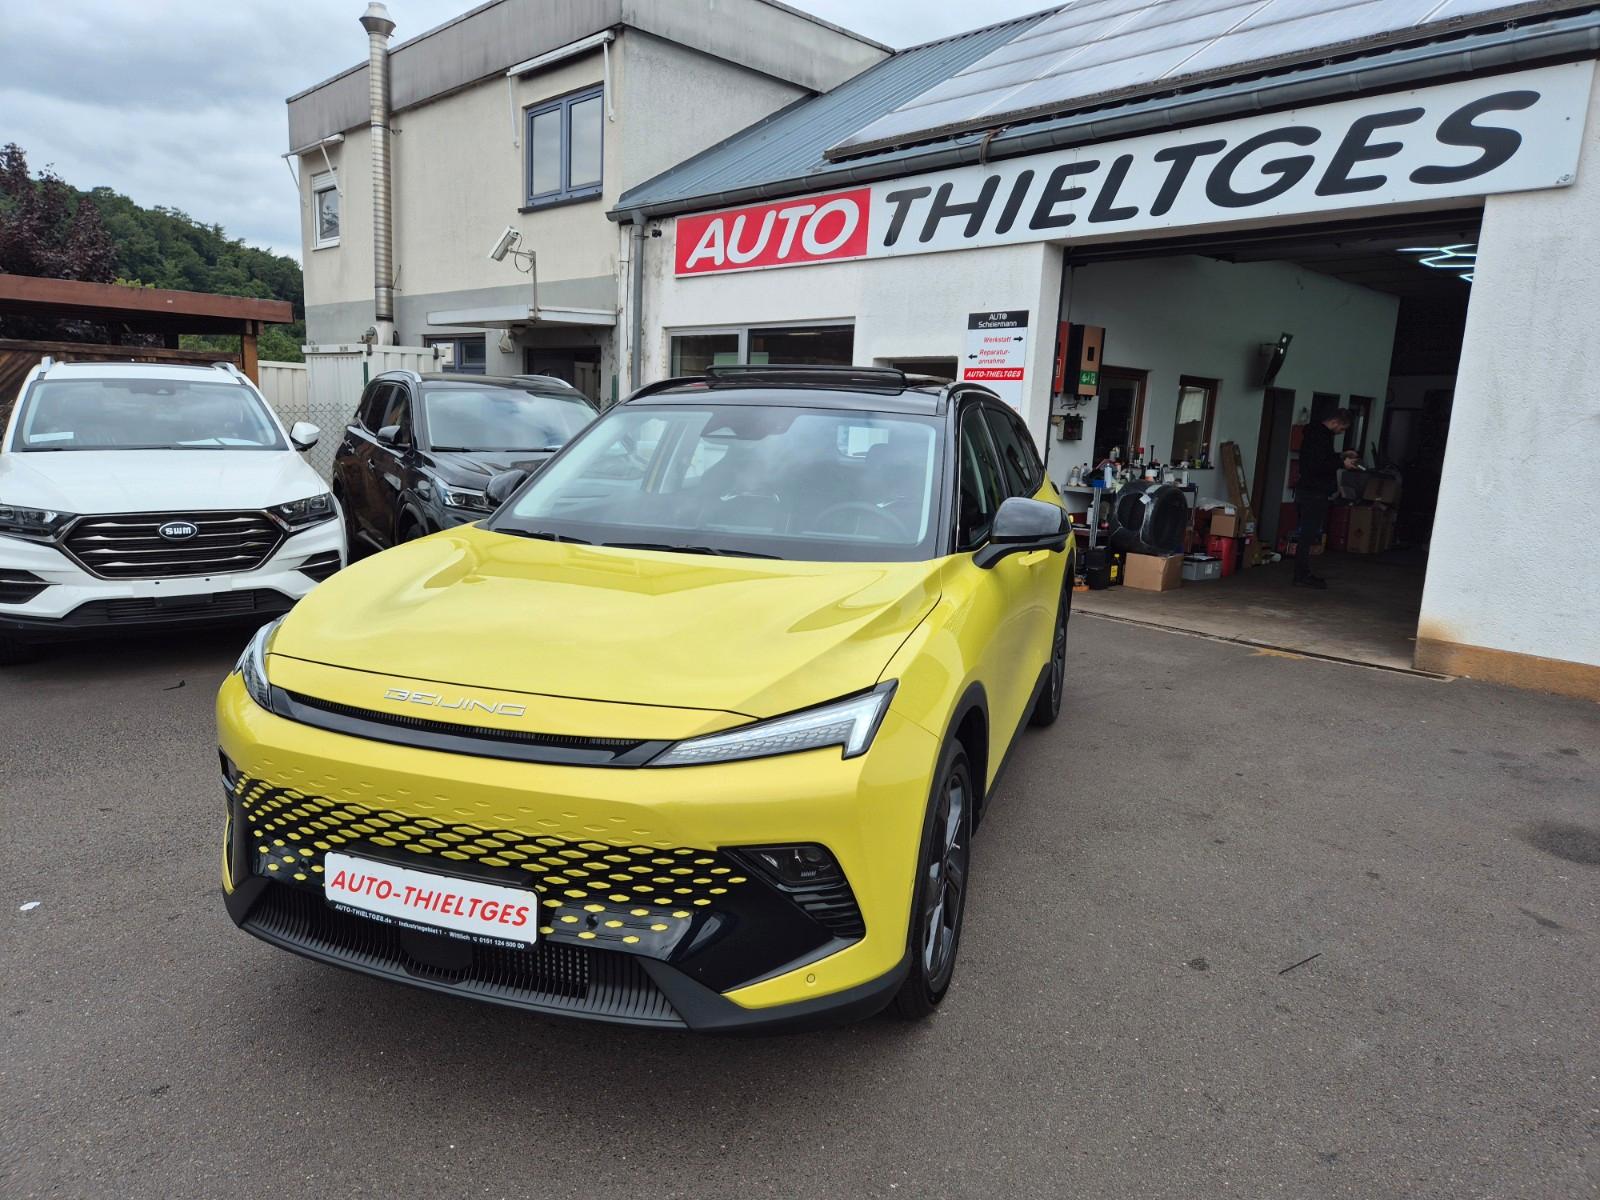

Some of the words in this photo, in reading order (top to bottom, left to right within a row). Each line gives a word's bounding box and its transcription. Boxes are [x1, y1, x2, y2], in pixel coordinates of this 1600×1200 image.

[685, 198, 860, 269] AUTO
[883, 89, 1542, 247] THIELTGES
[966, 370, 1022, 378] AUTO-THIELTGES
[383, 687, 528, 717] BEIJING
[331, 870, 530, 927] AUTO-THIELTGES
